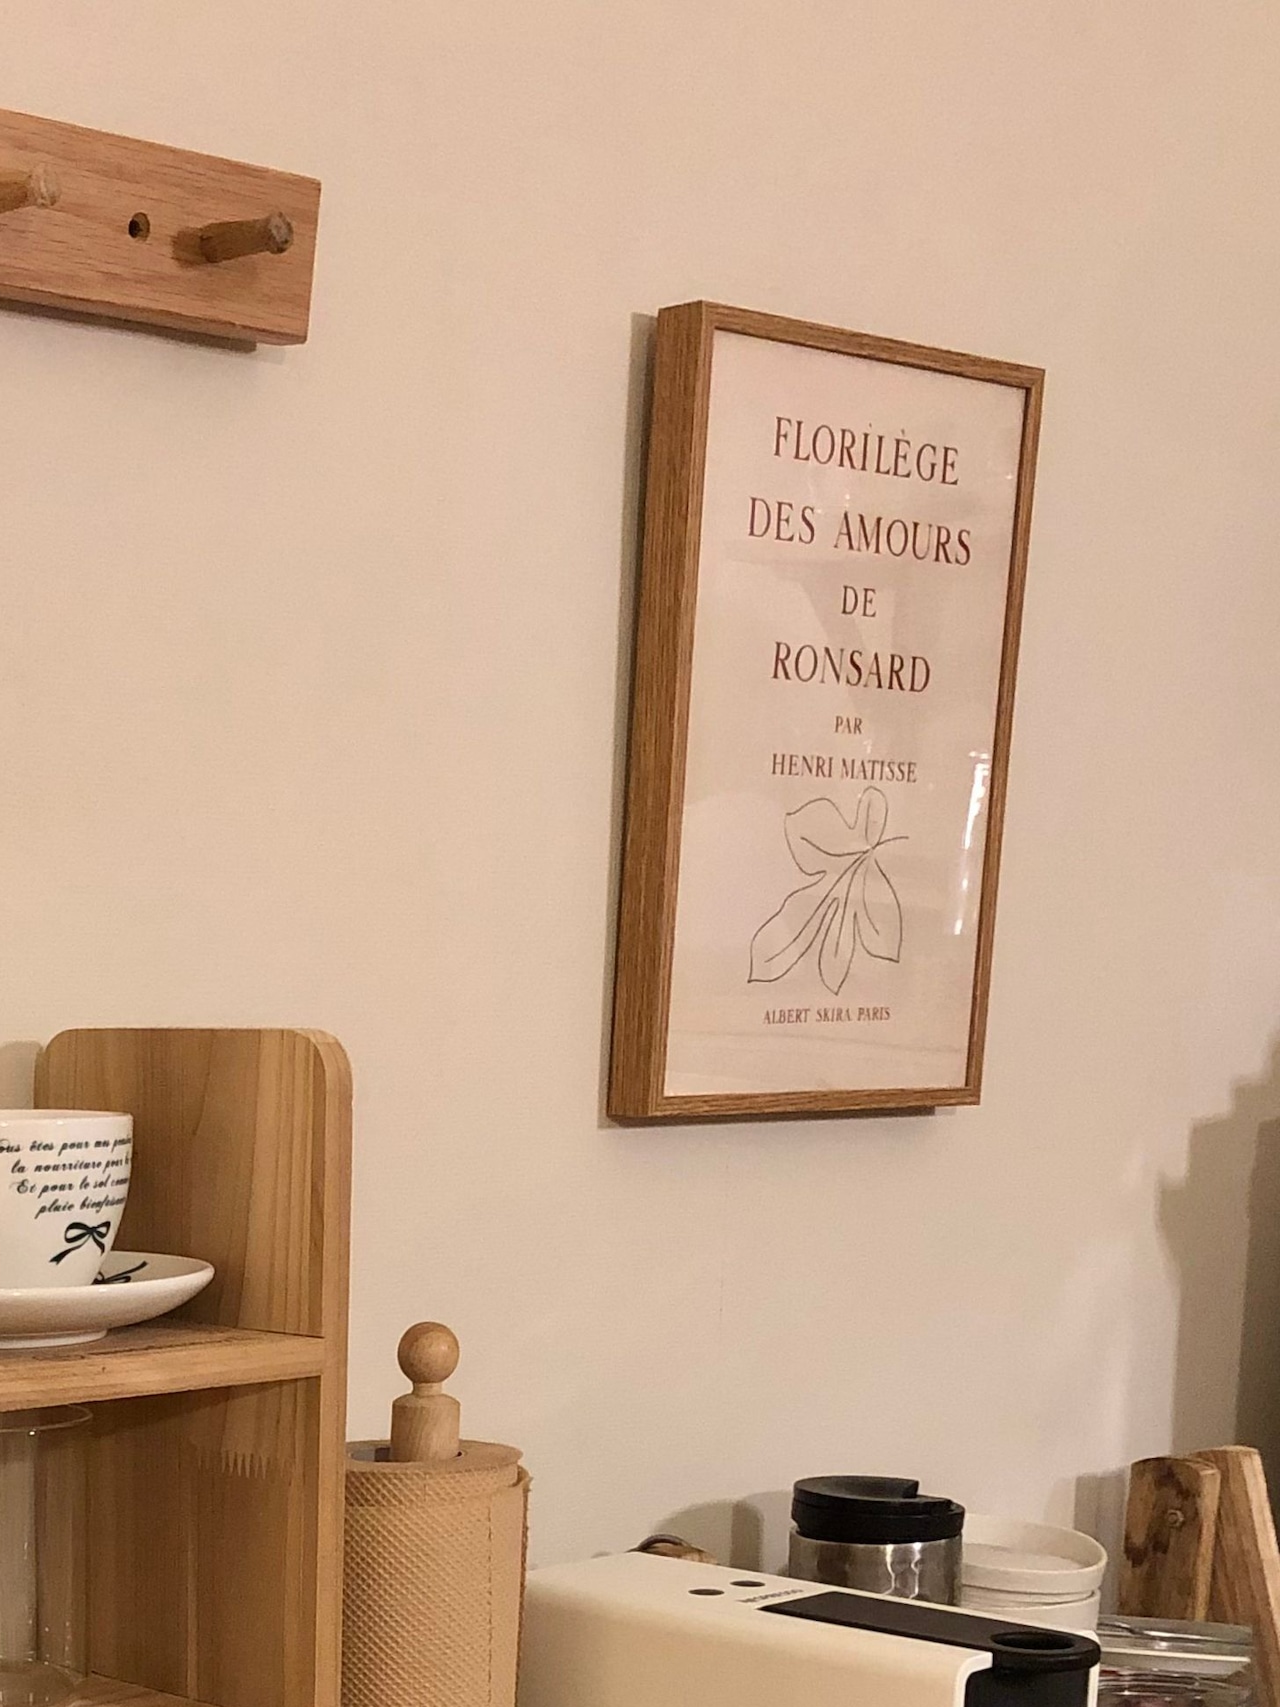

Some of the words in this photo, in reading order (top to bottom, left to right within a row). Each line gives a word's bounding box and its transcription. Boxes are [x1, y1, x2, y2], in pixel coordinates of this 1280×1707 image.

[748, 496, 816, 544] DES
[833, 510, 971, 566] AMOURS
[841, 585, 877, 618] DE
[772, 641, 931, 693] RONSARD
[834, 716, 863, 735] PAR
[771, 753, 833, 778] HENRI
[840, 759, 918, 783] MATISSE
[763, 1008, 810, 1024] ALBERT
[815, 1007, 852, 1022] SKIRA
[857, 1006, 891, 1021] PARIS
[58, 1141, 90, 1156] pour
[11, 1160, 26, 1174] la
[38, 1182, 74, 1199] pour
[79, 1175, 90, 1190] le
[93, 1174, 111, 1189] sol
